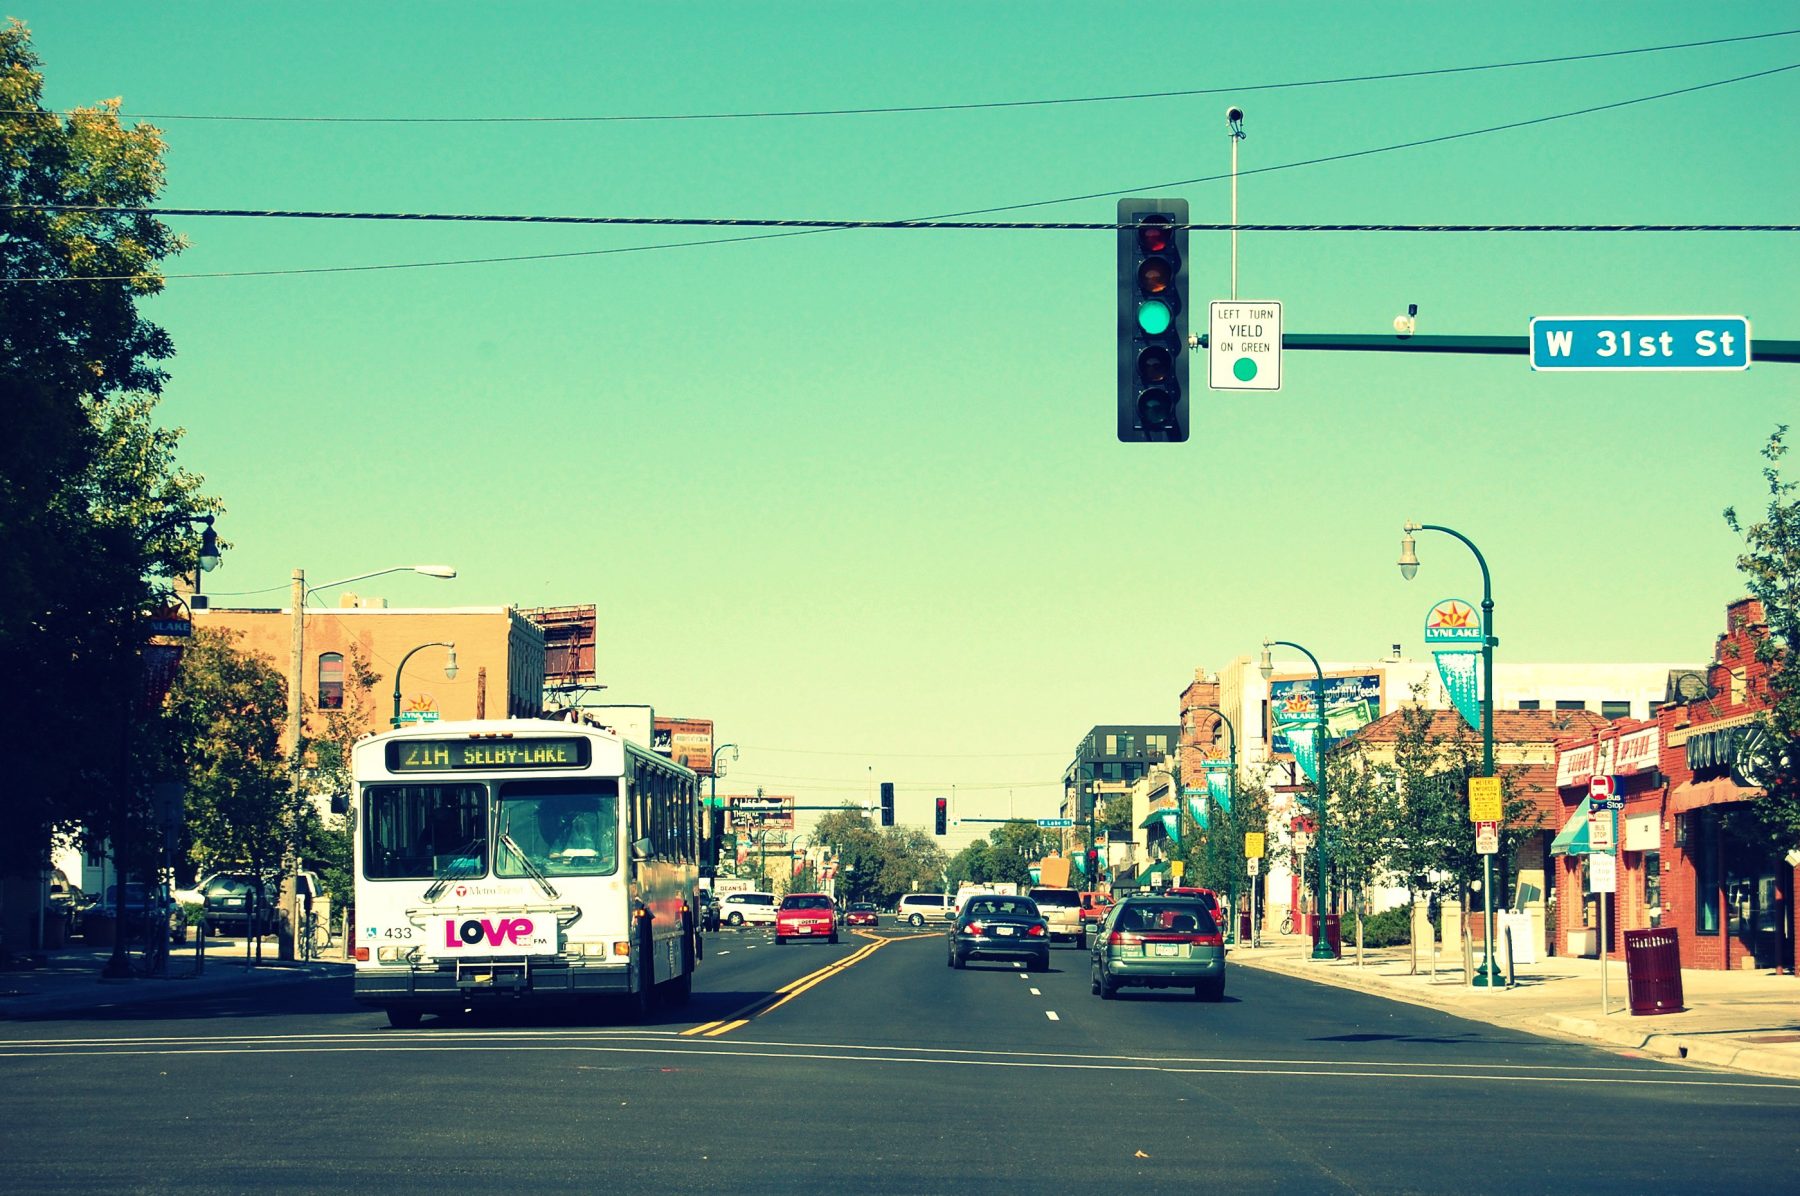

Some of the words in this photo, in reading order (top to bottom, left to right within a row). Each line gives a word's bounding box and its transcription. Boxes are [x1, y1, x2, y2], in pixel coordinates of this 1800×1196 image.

[1218, 309, 1240, 319] LEFT
[1249, 309, 1274, 319] TURN
[1229, 324, 1263, 337] YIELD
[1220, 342, 1233, 352] ON
[1241, 342, 1270, 352] GREEN
[1546, 331, 1573, 357] W
[1596, 330, 1674, 357] 31st
[1695, 329, 1735, 357] St
[1427, 628, 1480, 638] LYNLAKE
[405, 742, 449, 765] 21A
[464, 743, 567, 764] SELBY-LAKE
[1606, 801, 1624, 811] Stop
[470, 886, 496, 896] Metro
[384, 928, 412, 939] 433
